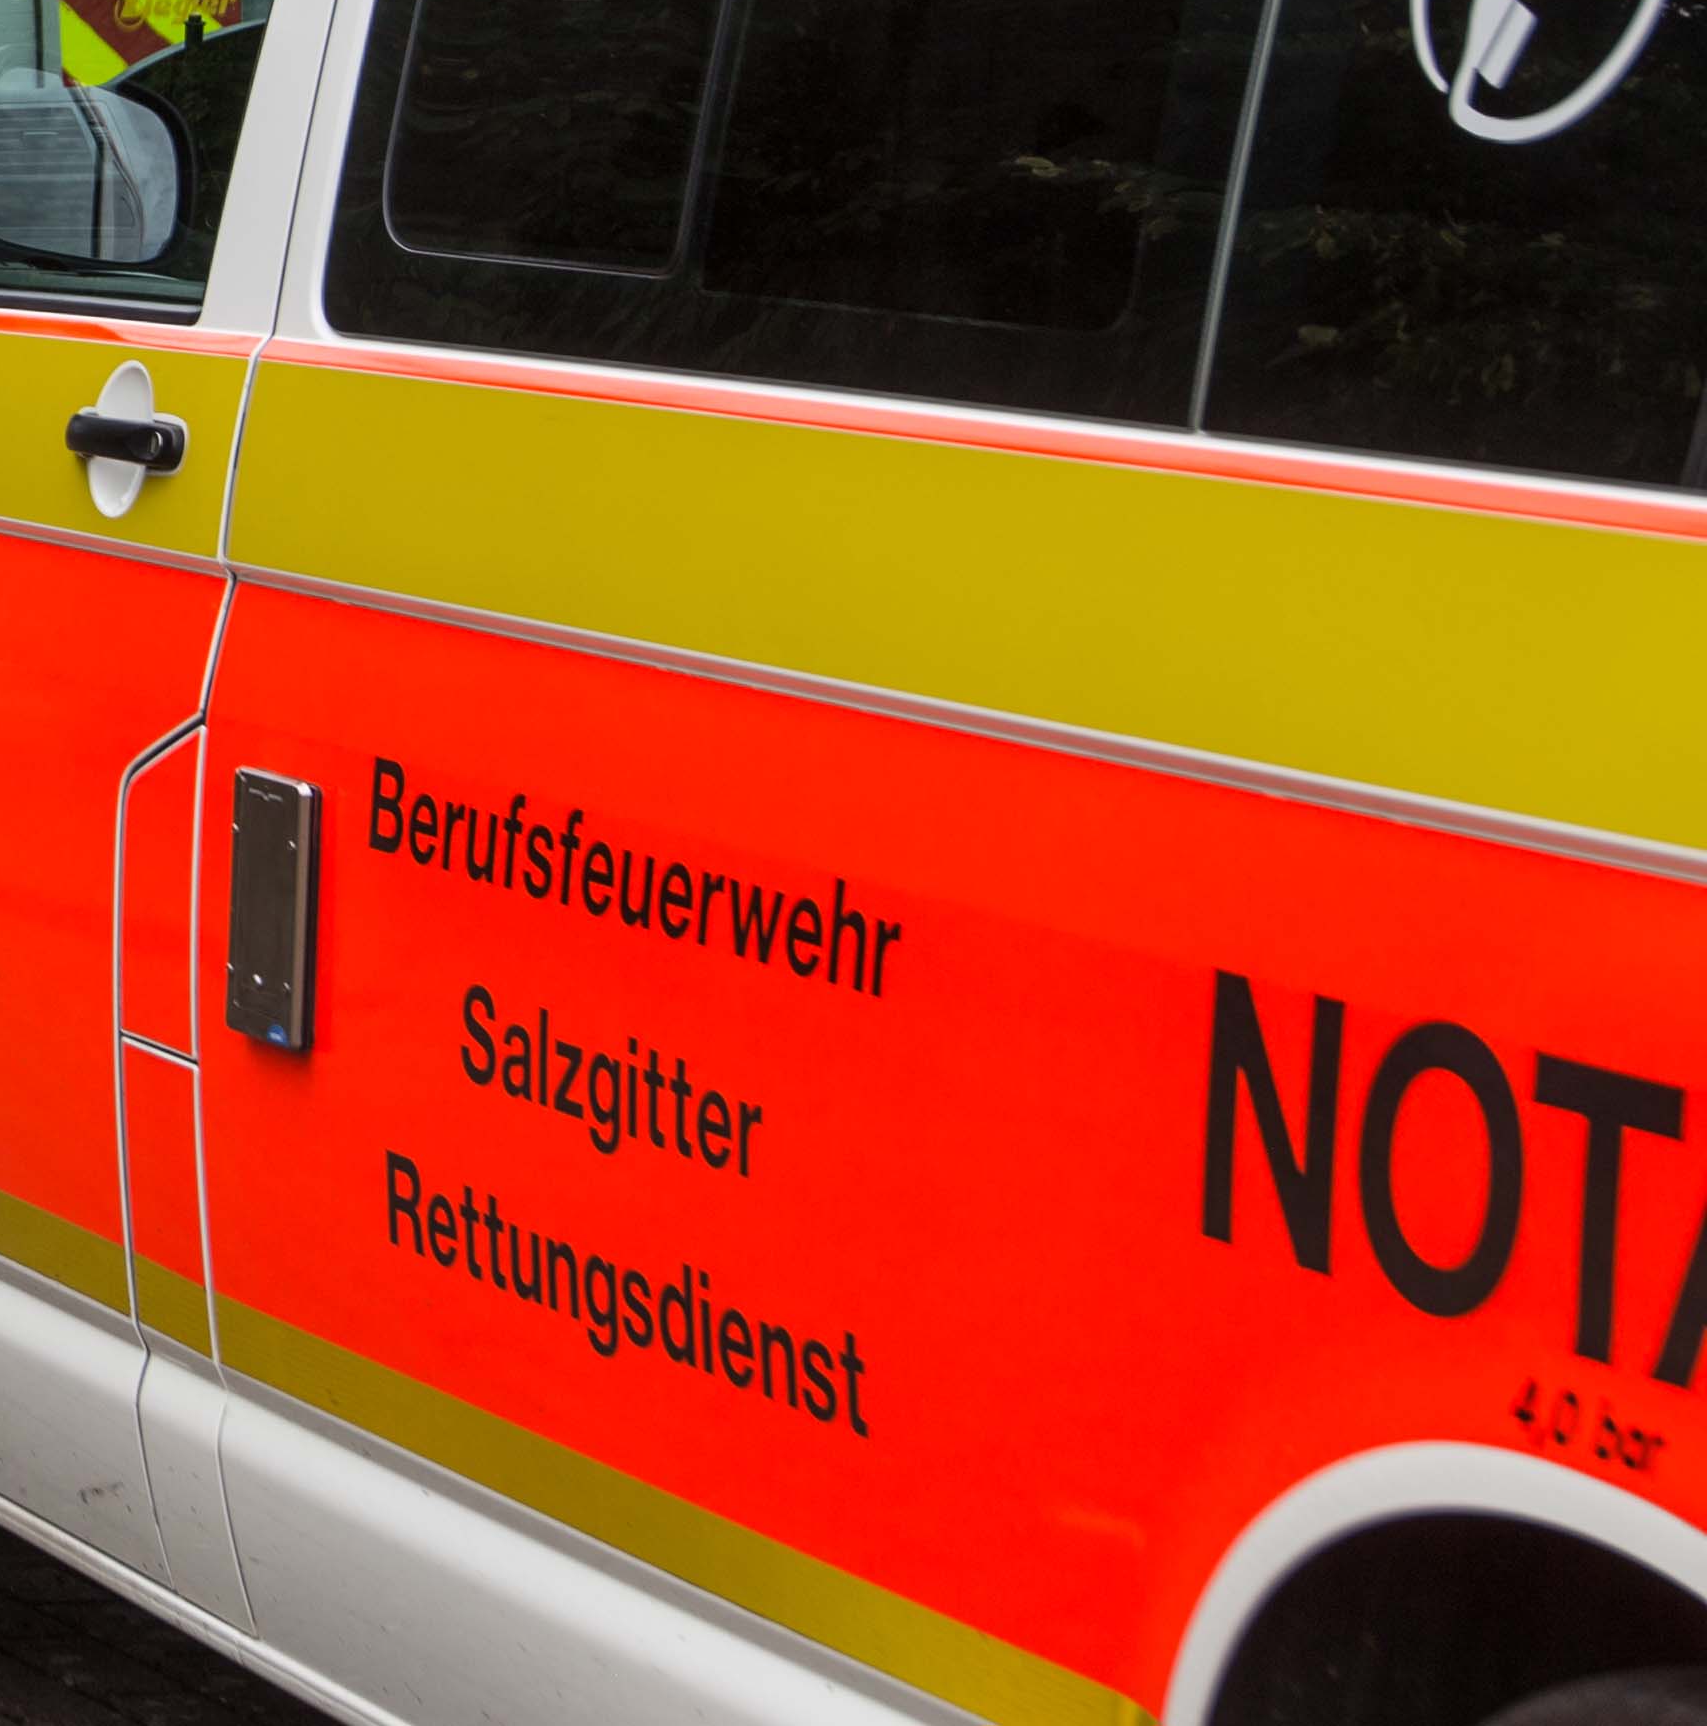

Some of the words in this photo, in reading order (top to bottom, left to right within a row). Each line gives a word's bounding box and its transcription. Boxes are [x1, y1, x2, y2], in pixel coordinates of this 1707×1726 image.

[368, 755, 902, 998] Berufsfeuerwehr
[460, 983, 762, 1178] Salzgitter
[386, 1148, 870, 1440] Rettungsdienst
